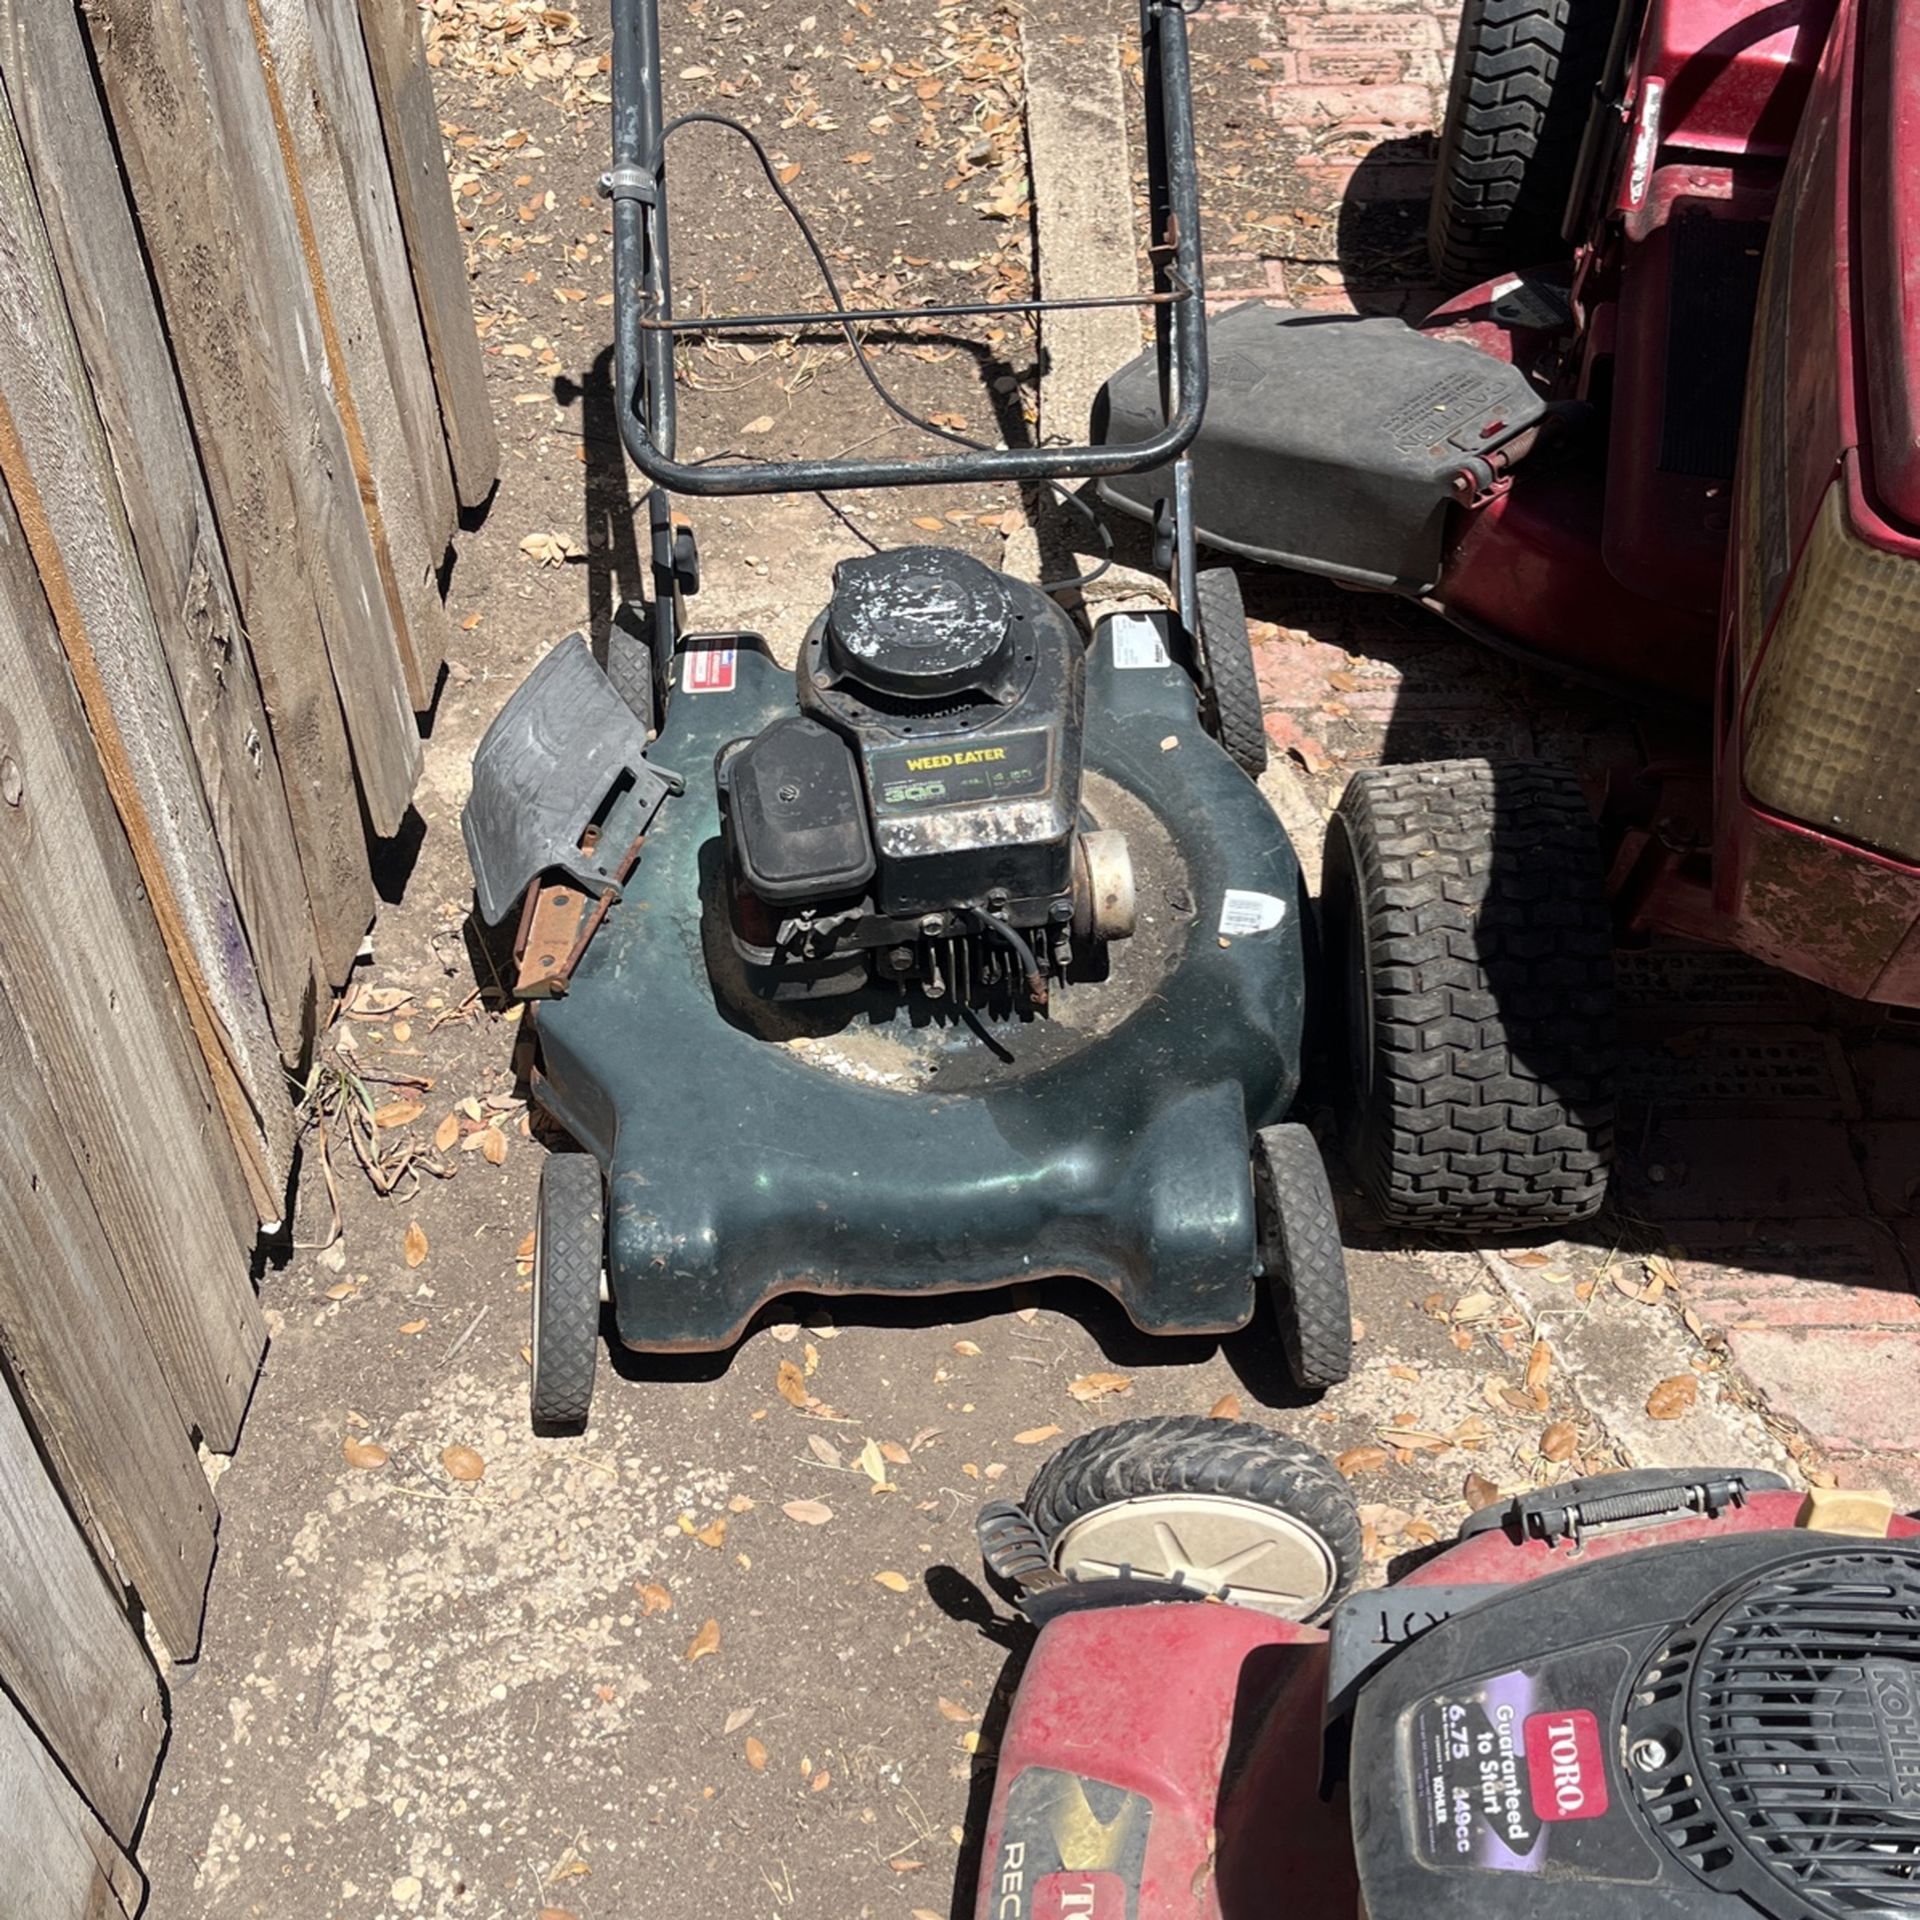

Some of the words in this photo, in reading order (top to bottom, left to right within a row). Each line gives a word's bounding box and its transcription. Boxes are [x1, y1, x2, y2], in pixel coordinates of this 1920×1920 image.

[1395, 381, 1506, 453] CAUTION
[906, 755, 953, 772] WEED
[954, 747, 1006, 765] EATER
[884, 784, 946, 803] 300
[1449, 1704, 1470, 1759] 6.75
[1477, 1732, 1494, 1754] to
[1480, 1760, 1502, 1814] Start
[1496, 1705, 1529, 1840] Guaranteed
[1548, 1718, 1584, 1811] TORO
[1432, 1776, 1447, 1825] KOHLER
[1061, 1883, 1095, 1920] T
